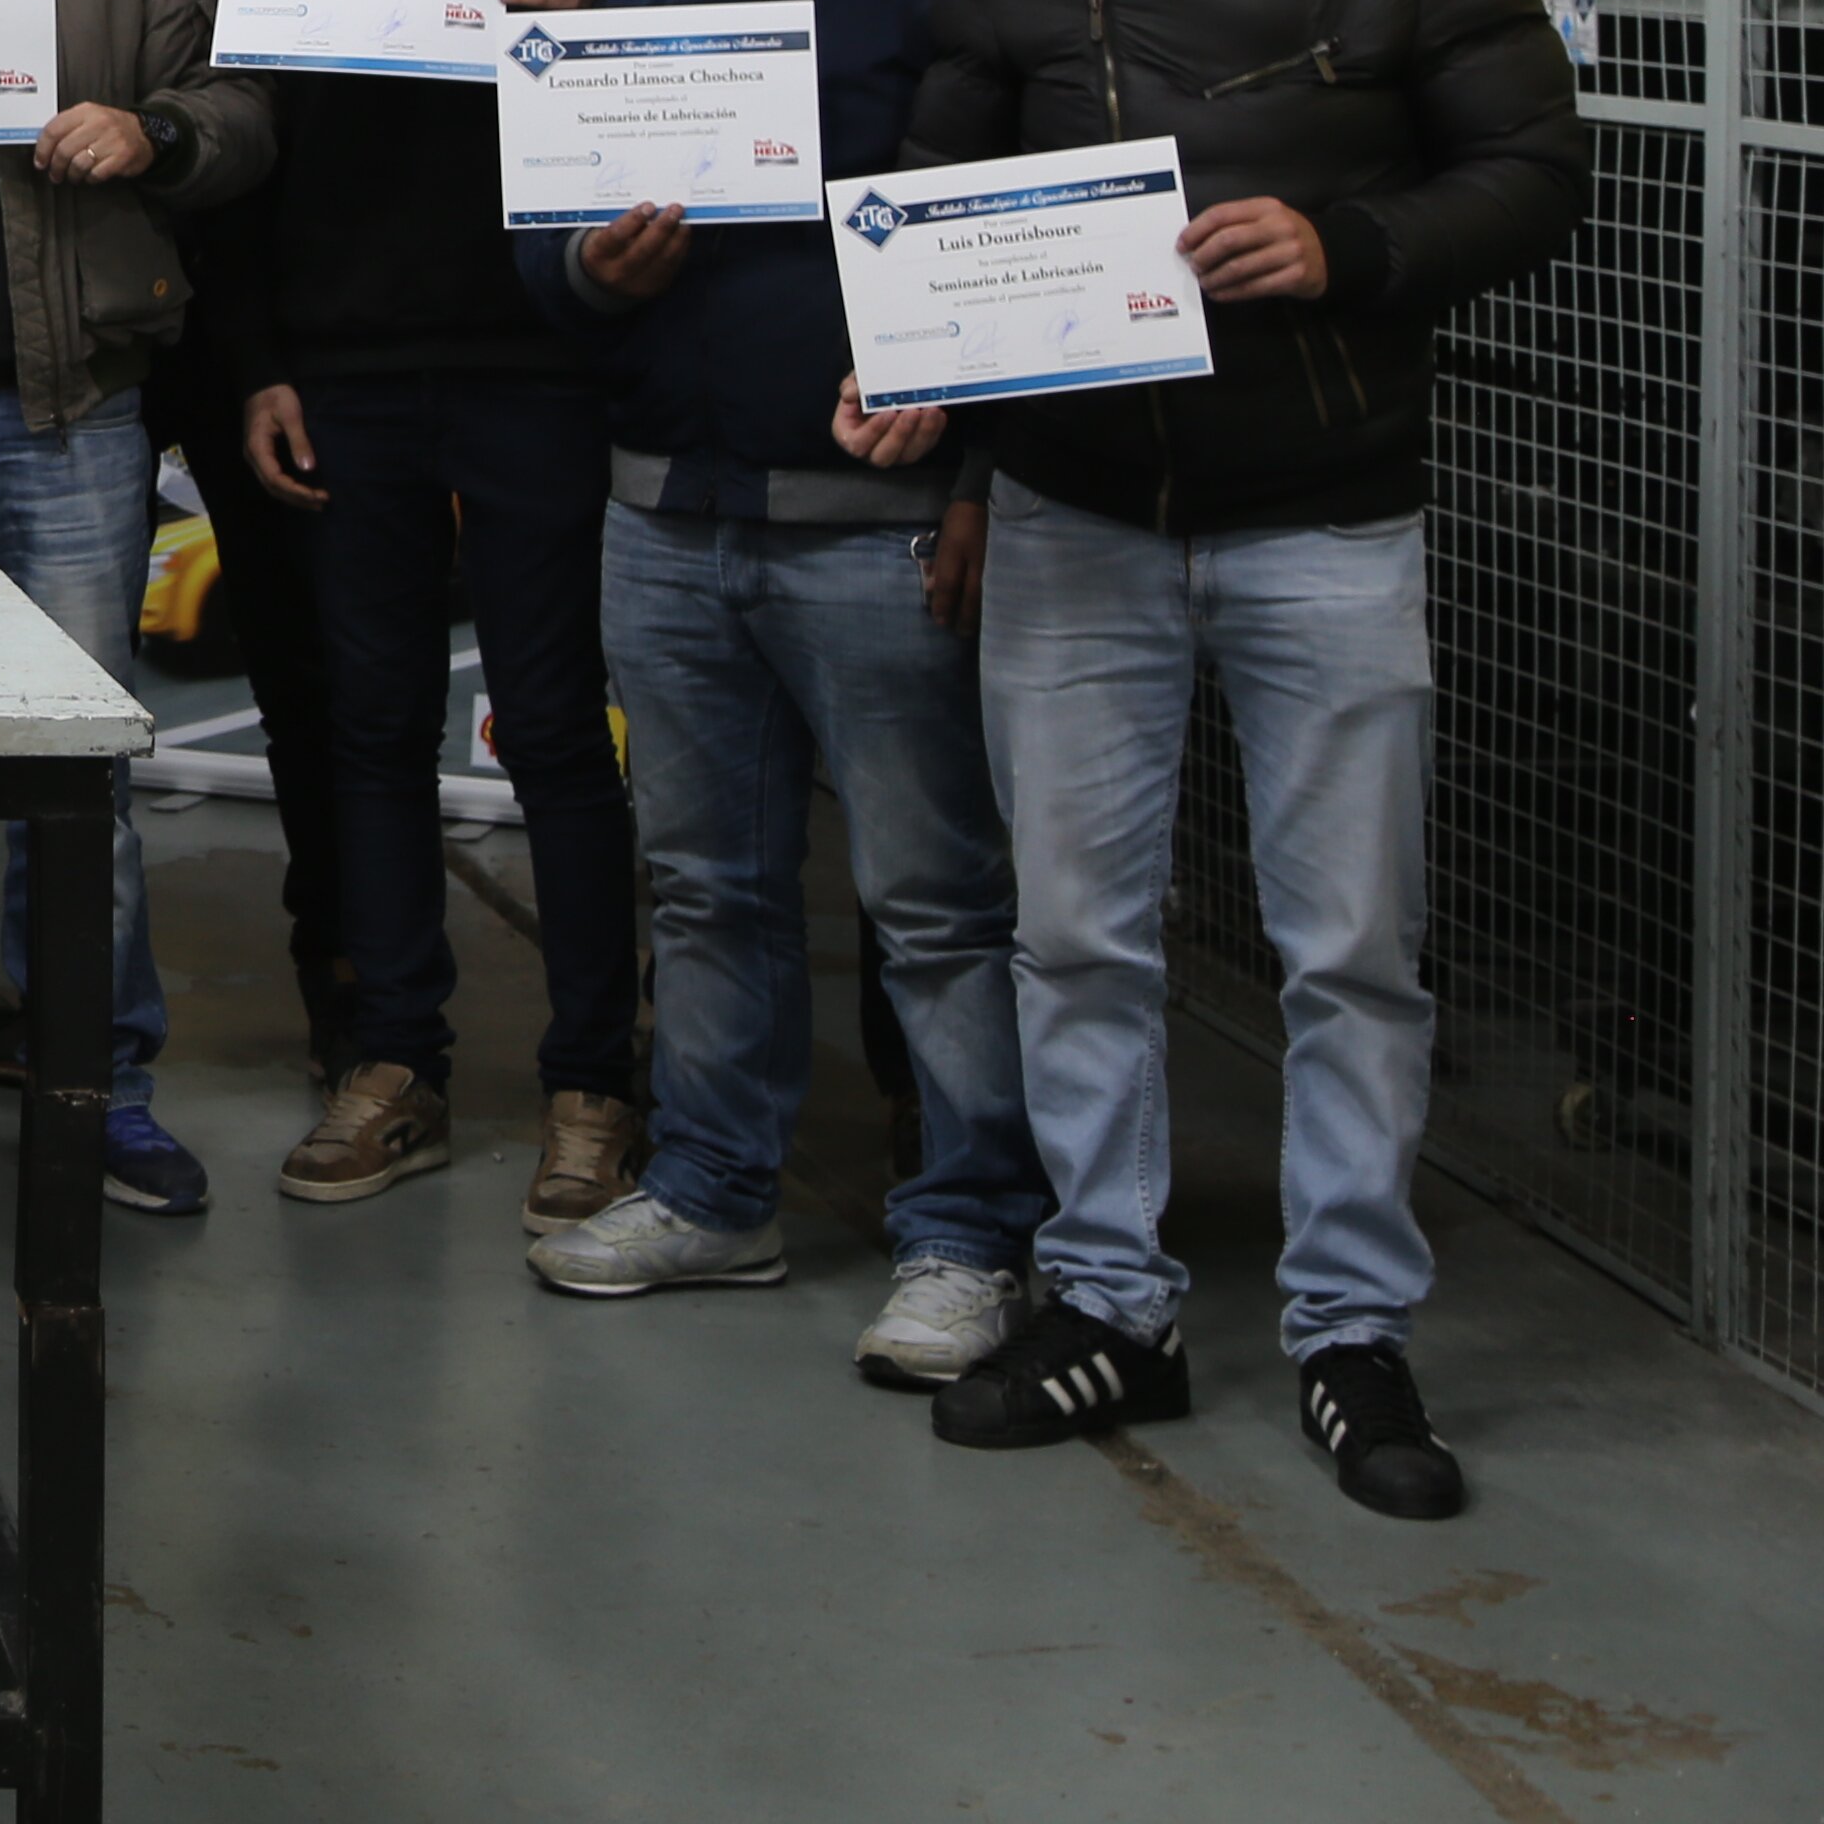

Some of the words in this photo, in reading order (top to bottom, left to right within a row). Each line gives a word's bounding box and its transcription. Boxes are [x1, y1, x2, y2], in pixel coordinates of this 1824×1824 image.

[446, 9, 484, 20] HELIX
[549, 74, 619, 90] Leonardo
[623, 72, 685, 87] Llamoca
[690, 69, 764, 84] Chochoca
[578, 111, 640, 125] Seminario
[644, 110, 658, 122] de
[662, 108, 736, 121] Lubricación
[754, 145, 796, 157] HELIX
[938, 235, 973, 252] Luis
[978, 222, 1082, 248] Dourisboure
[929, 276, 998, 294] Seminario
[1002, 271, 1018, 285] de
[1021, 262, 1104, 283] Lubricación
[1128, 296, 1176, 312] HELIX
